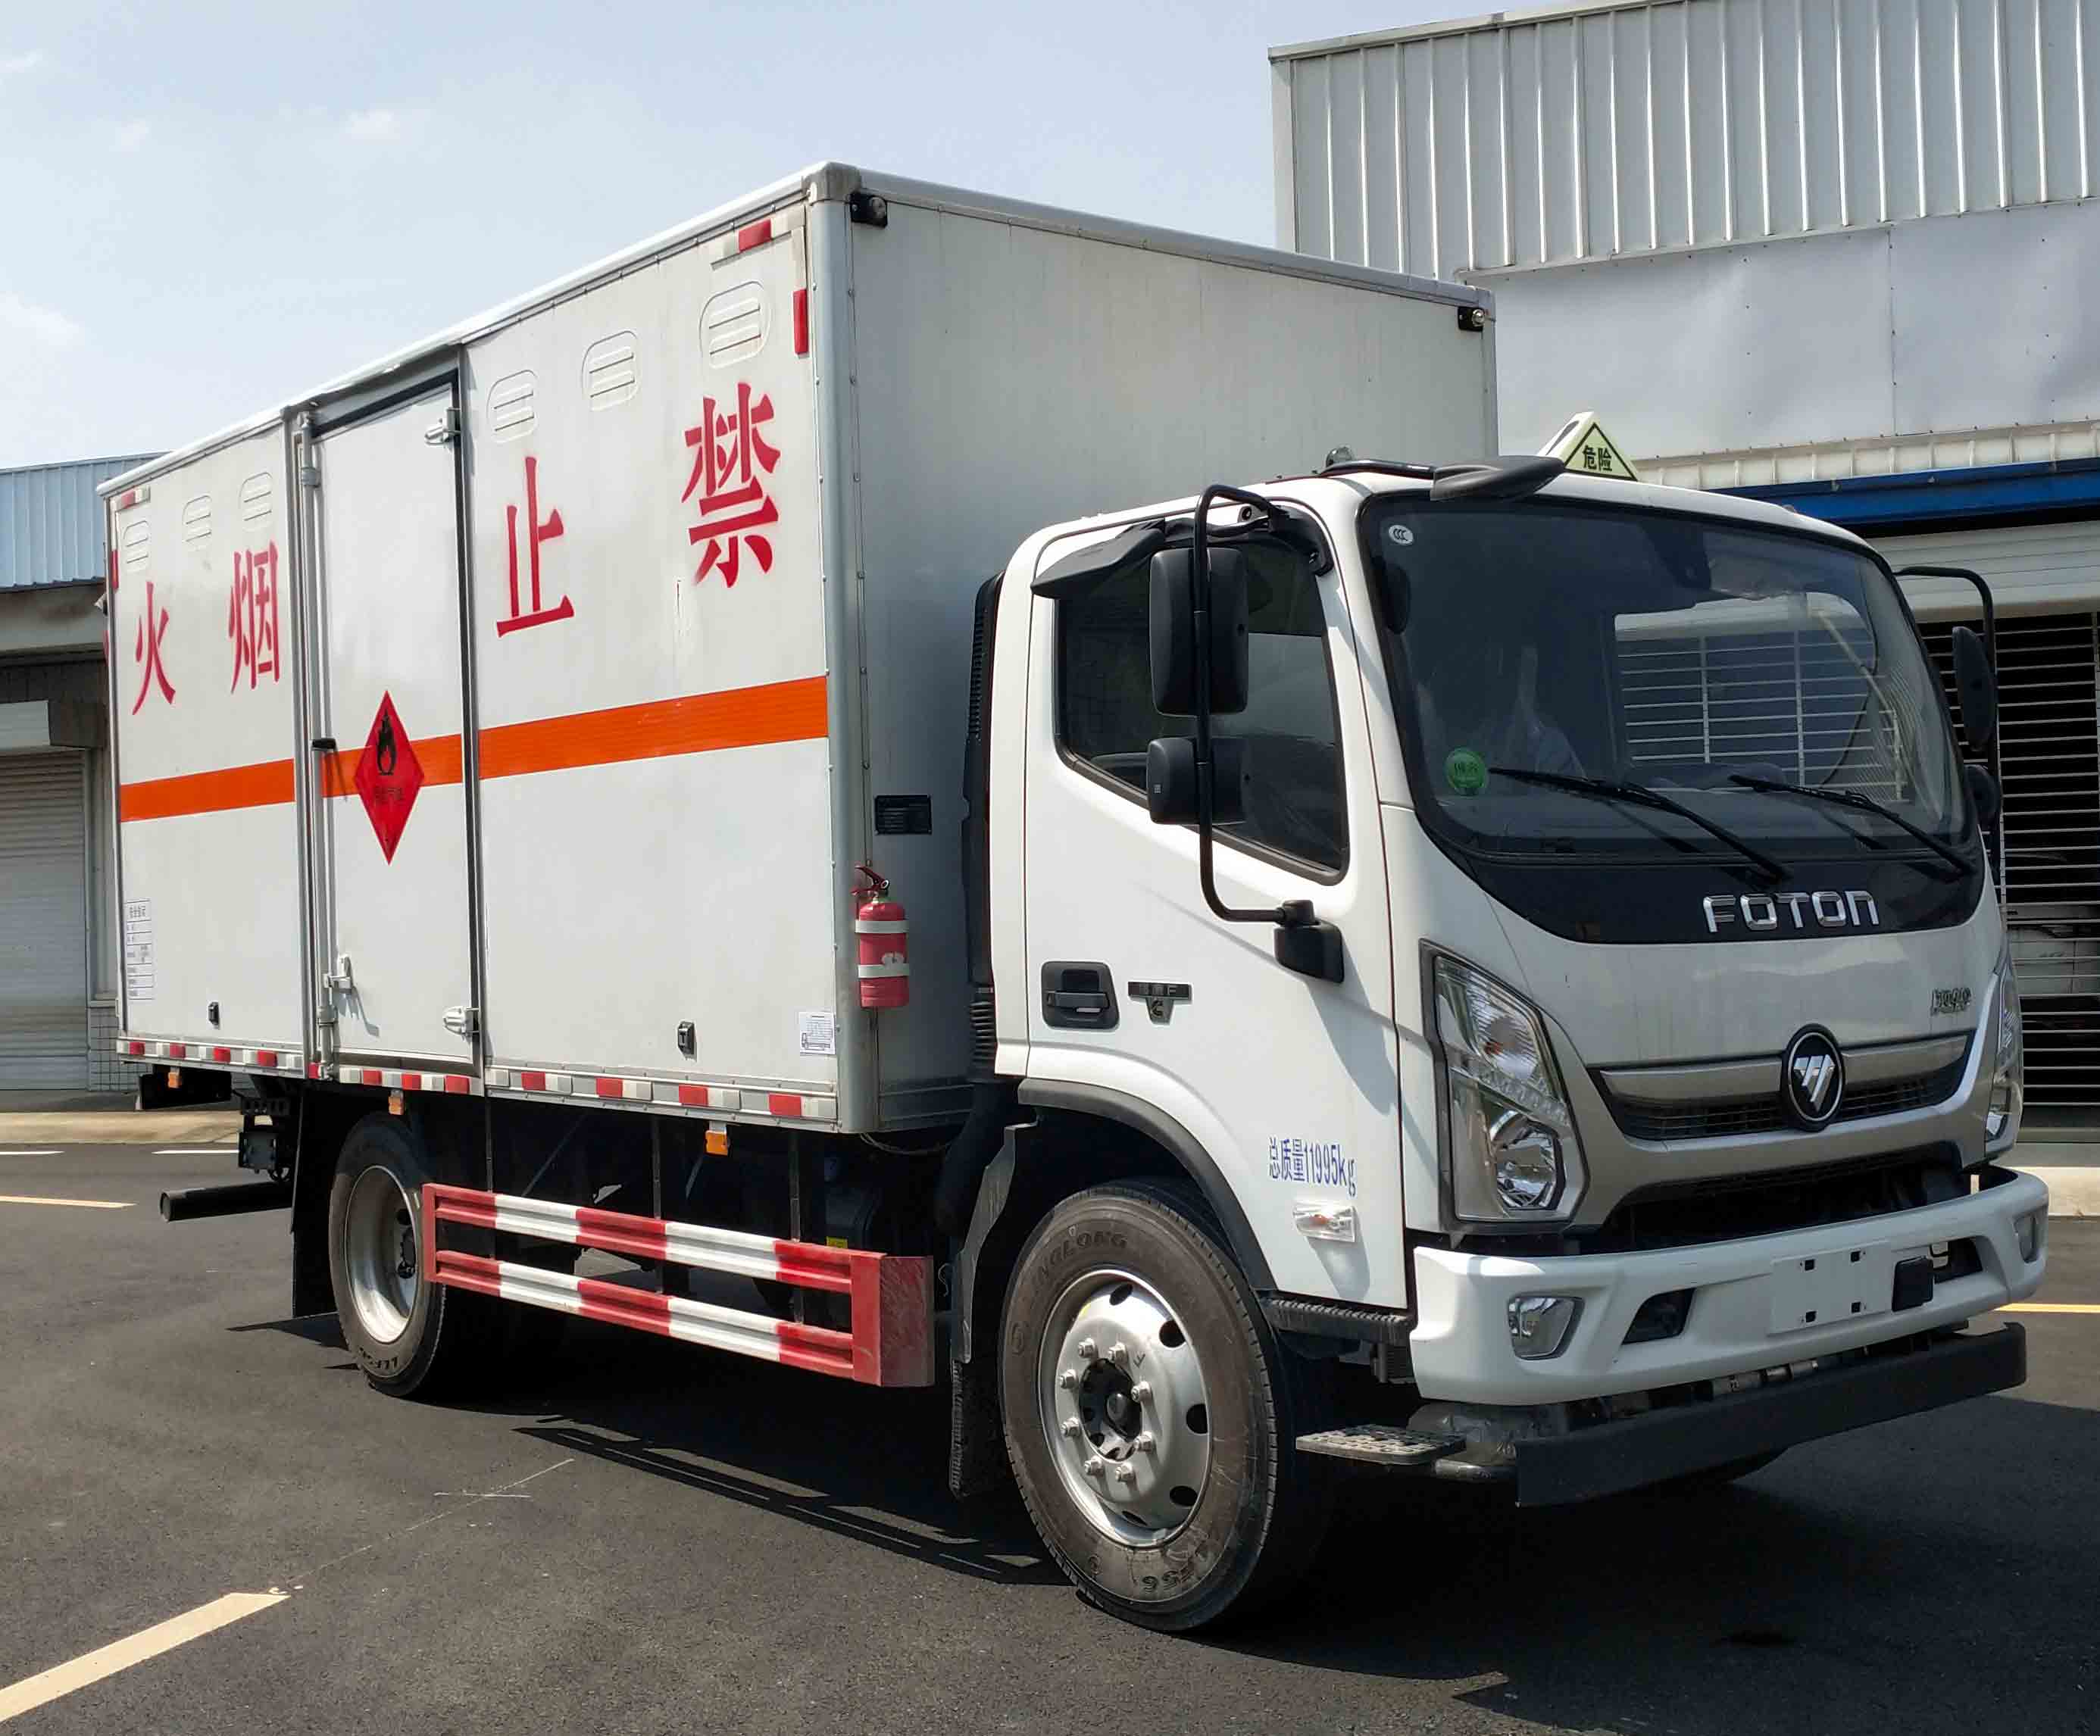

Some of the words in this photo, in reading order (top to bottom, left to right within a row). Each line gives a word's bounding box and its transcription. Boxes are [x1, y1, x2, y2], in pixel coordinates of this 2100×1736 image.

[1582, 445, 1613, 471] 危险
[133, 582, 176, 715] 火
[228, 542, 280, 693] 烟
[497, 457, 575, 637] 止
[682, 382, 781, 589] 禁
[1702, 890, 1880, 933] FOTON
